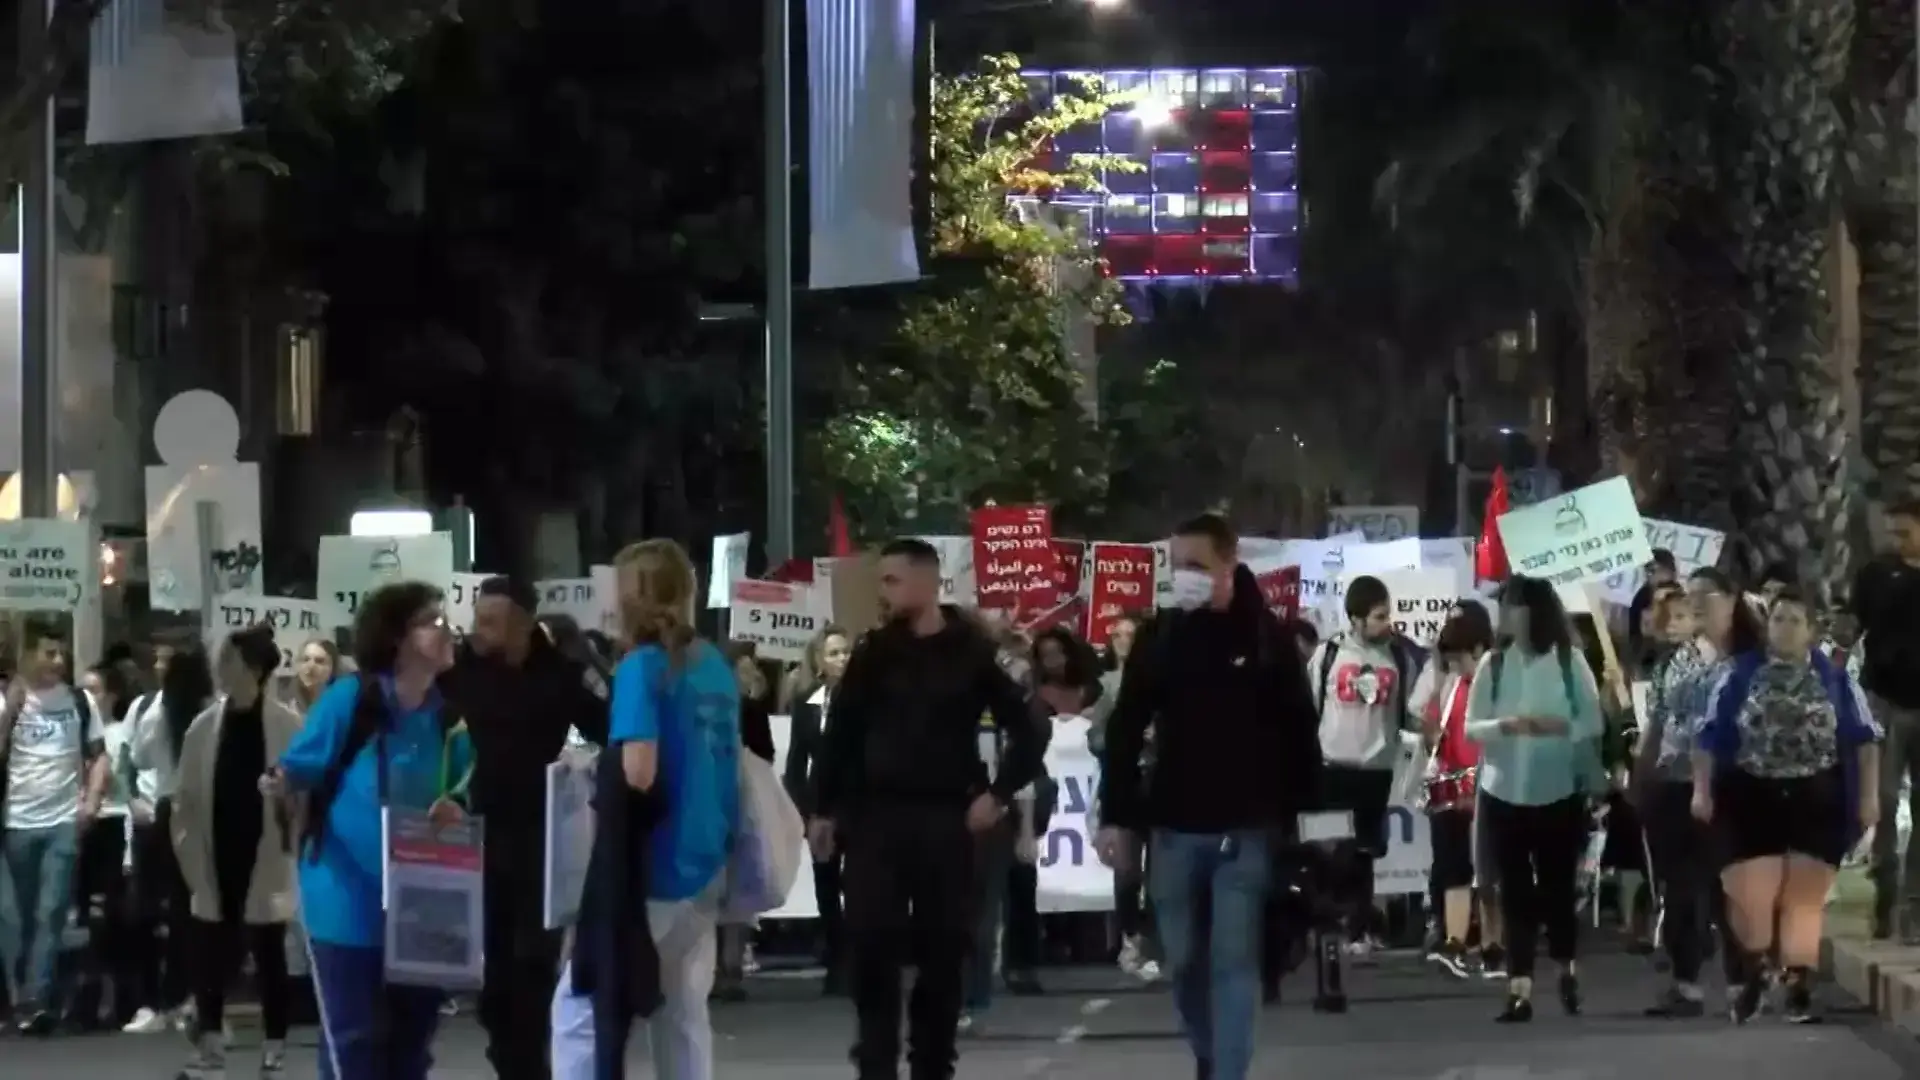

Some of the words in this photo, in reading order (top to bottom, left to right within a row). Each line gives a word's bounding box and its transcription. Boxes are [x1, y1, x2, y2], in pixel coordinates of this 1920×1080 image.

[986, 524, 1019, 537] נשים
[26, 547, 65, 560] are
[8, 563, 78, 580] alone
[1397, 599, 1420, 613] יש
[749, 608, 761, 624] 5
[768, 611, 814, 631] מתוך
[1413, 619, 1438, 637] אין
